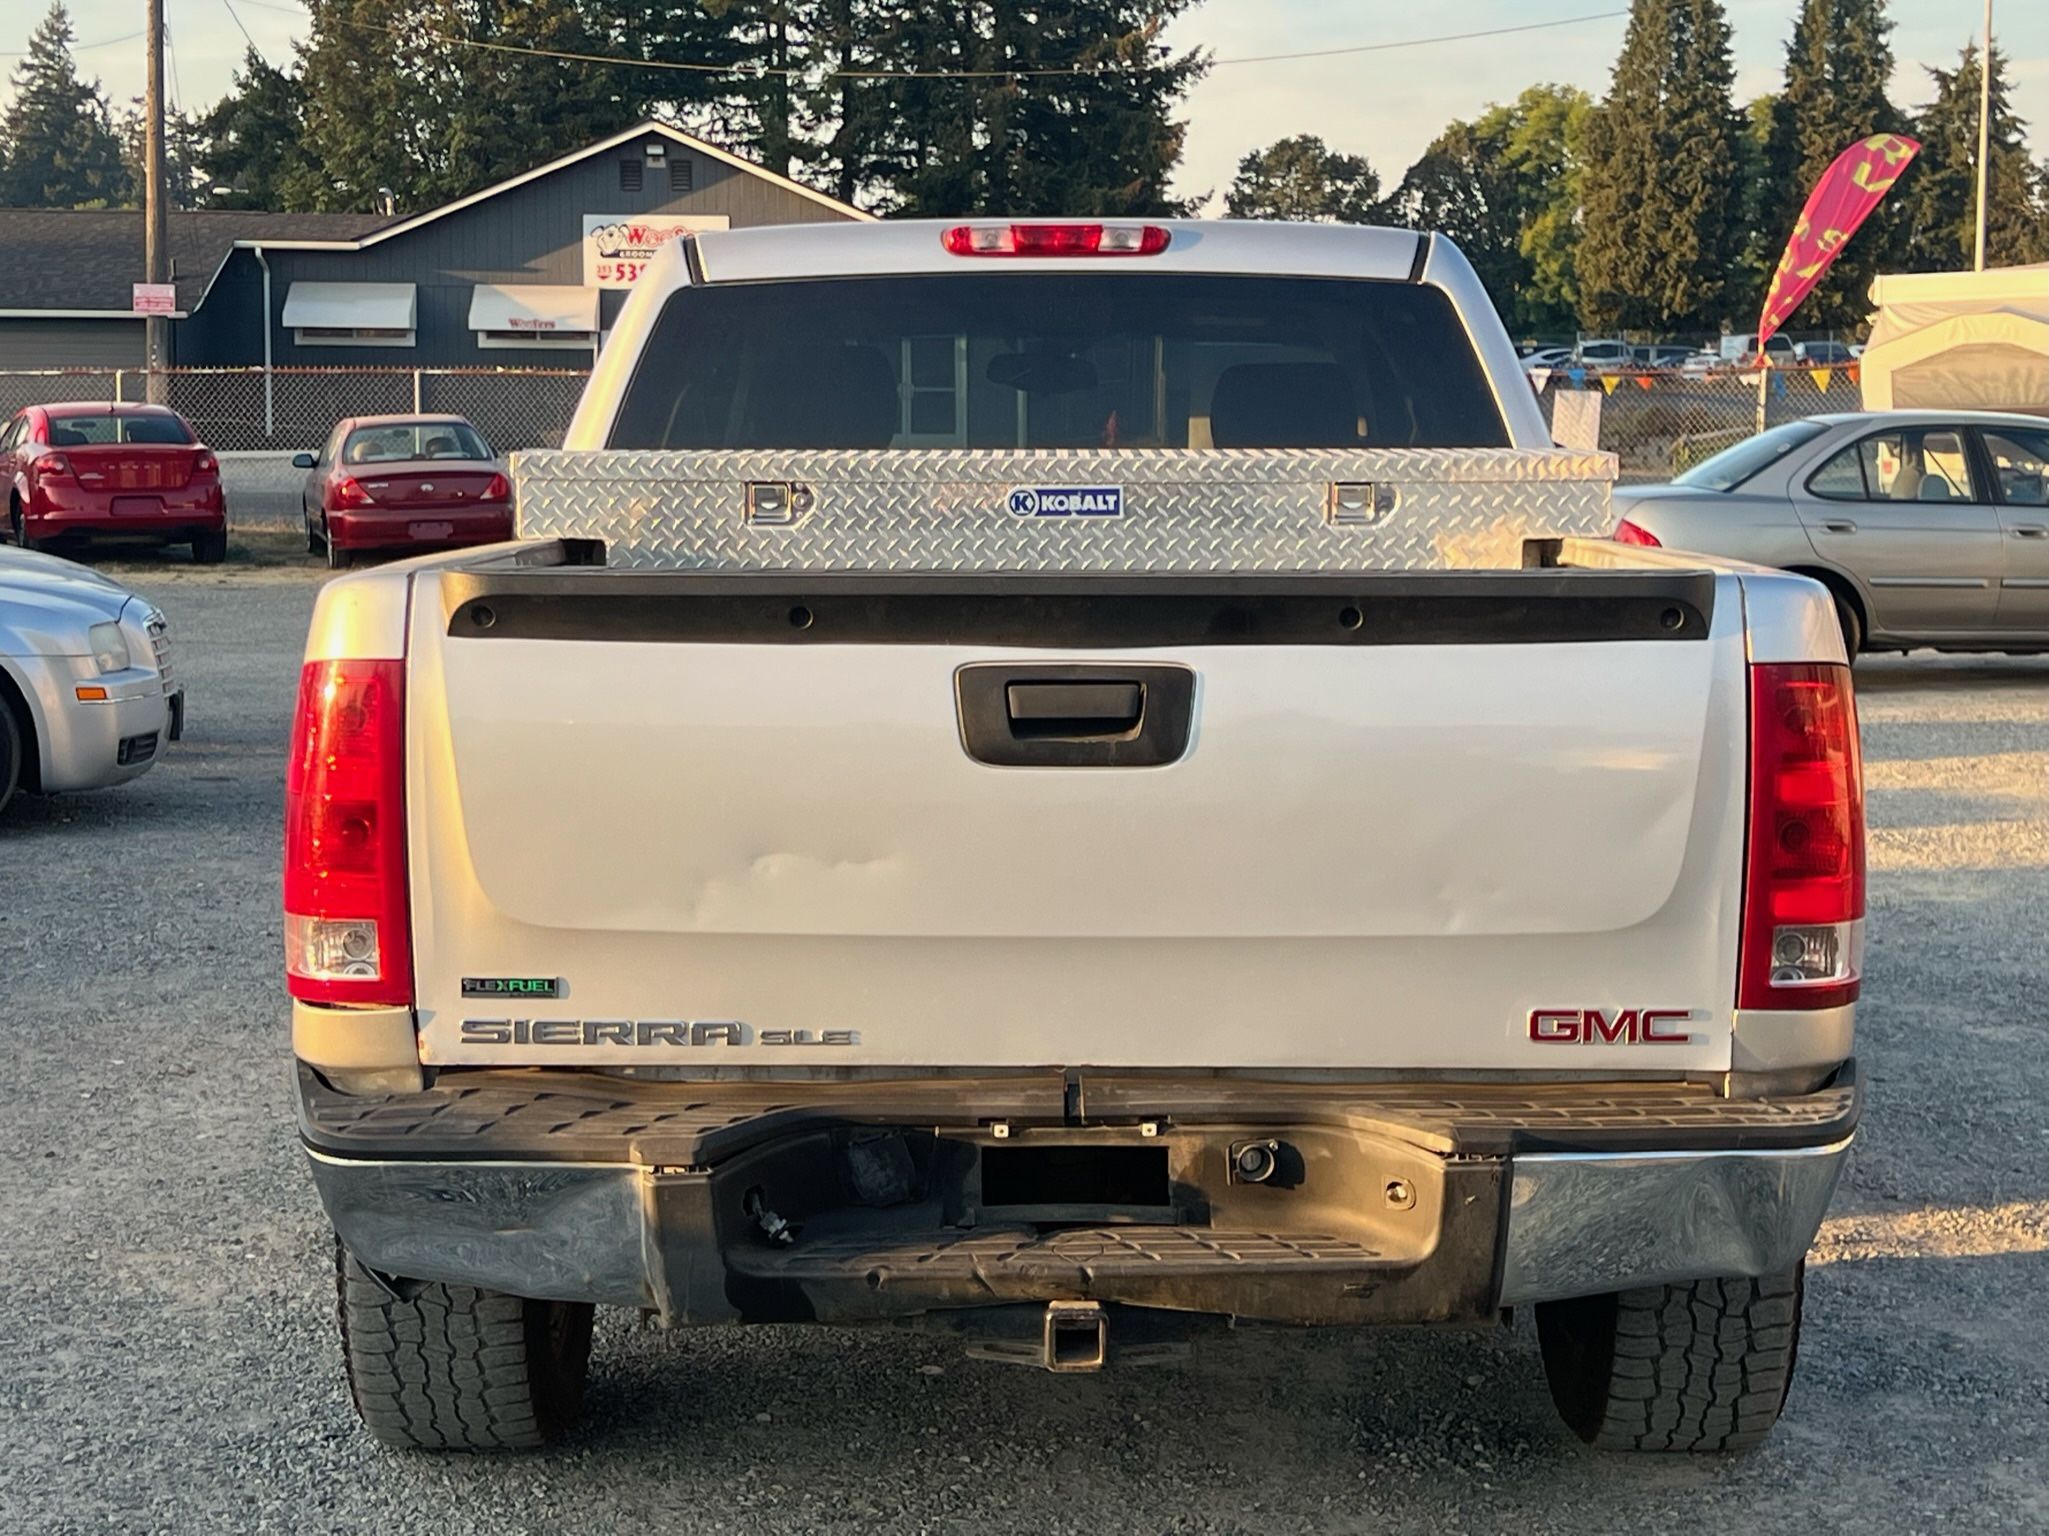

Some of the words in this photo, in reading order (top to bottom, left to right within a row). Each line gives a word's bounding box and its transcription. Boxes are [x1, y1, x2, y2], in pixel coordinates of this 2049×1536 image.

[616, 263, 647, 282] 53
[1041, 494, 1118, 512] KOBALT
[463, 980, 553, 992] FLEXFUEL
[461, 1018, 744, 1046] SIERRA
[760, 1029, 853, 1046] SLE
[1527, 1007, 1692, 1044] GMC
